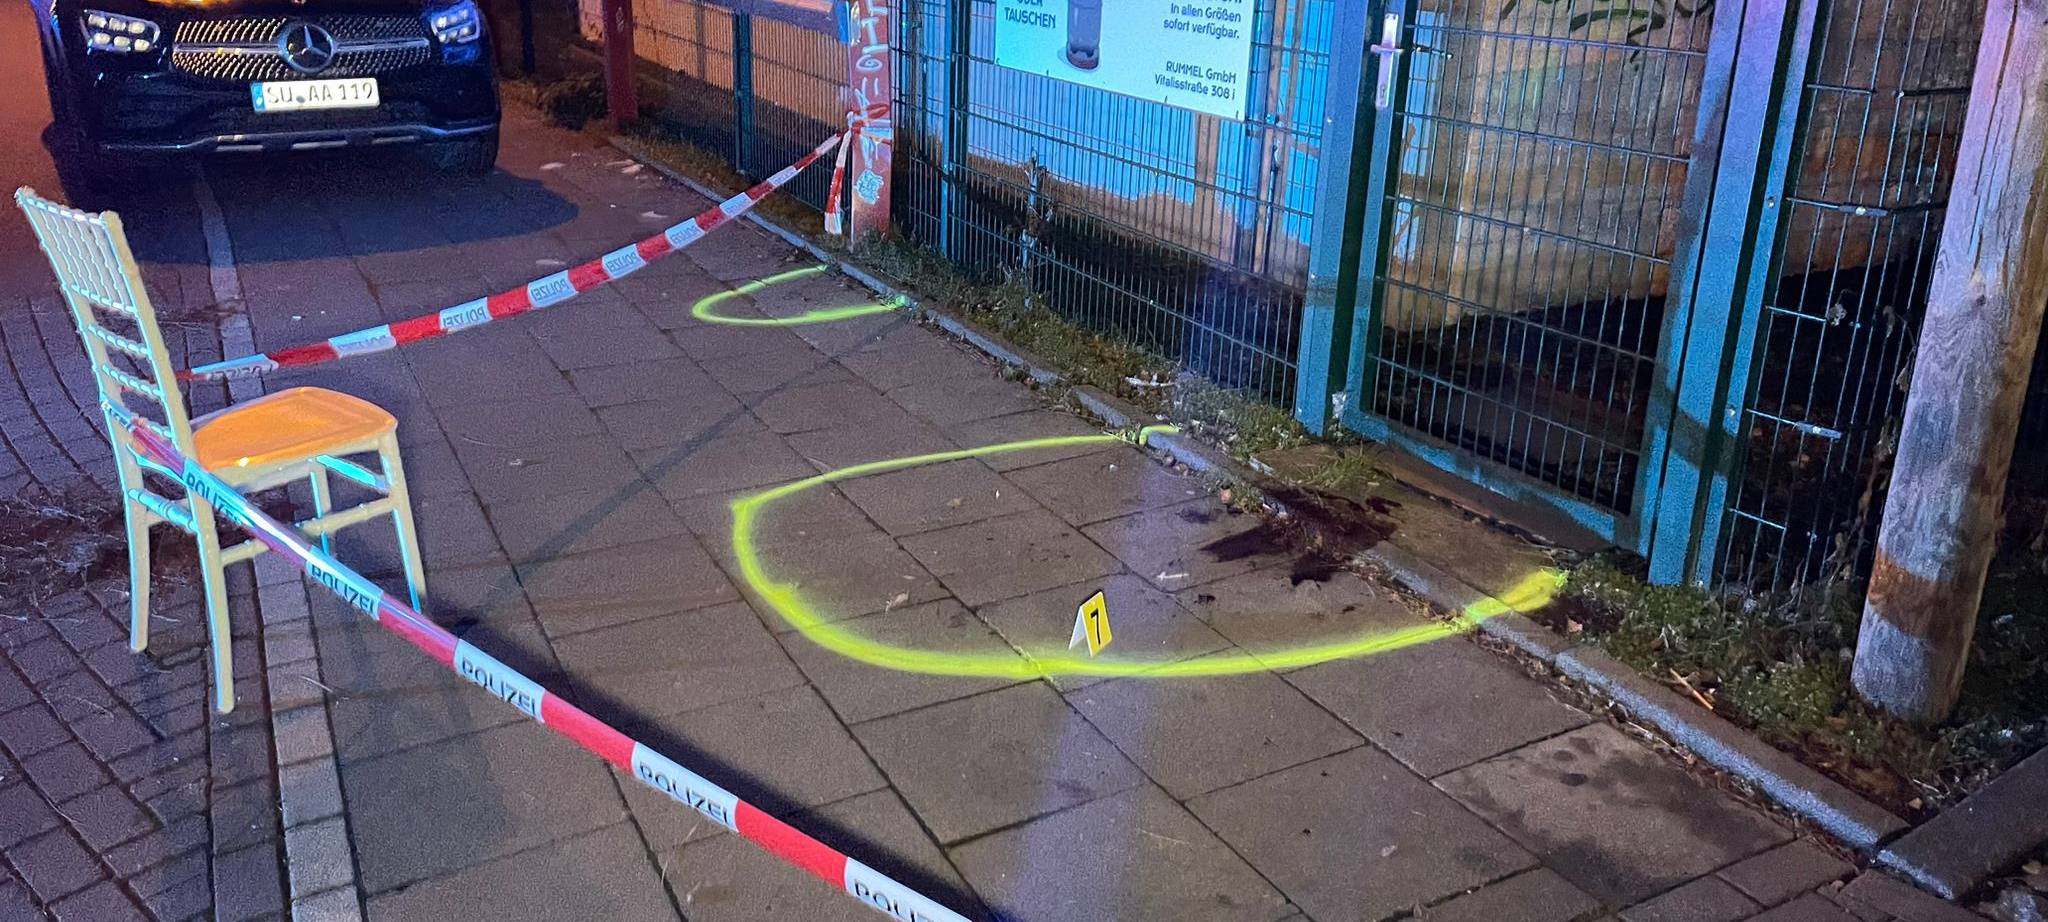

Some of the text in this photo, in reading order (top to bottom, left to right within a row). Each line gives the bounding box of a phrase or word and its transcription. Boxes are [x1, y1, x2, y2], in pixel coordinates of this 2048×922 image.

[1004, 7, 1056, 28] TAUSCHEN
[1170, 3, 1241, 22] In allen Größen
[1163, 18, 1240, 40] sofort verfügbar.
[1166, 60, 1237, 84] RUMMEL GmbH
[267, 82, 373, 103] SU AA 119
[1155, 73, 1209, 95] Vitalisstraße
[1211, 85, 1230, 99] 308
[462, 655, 536, 714] POLIZEI
[640, 761, 728, 824] POLIZEI
[854, 879, 935, 922] POLI
